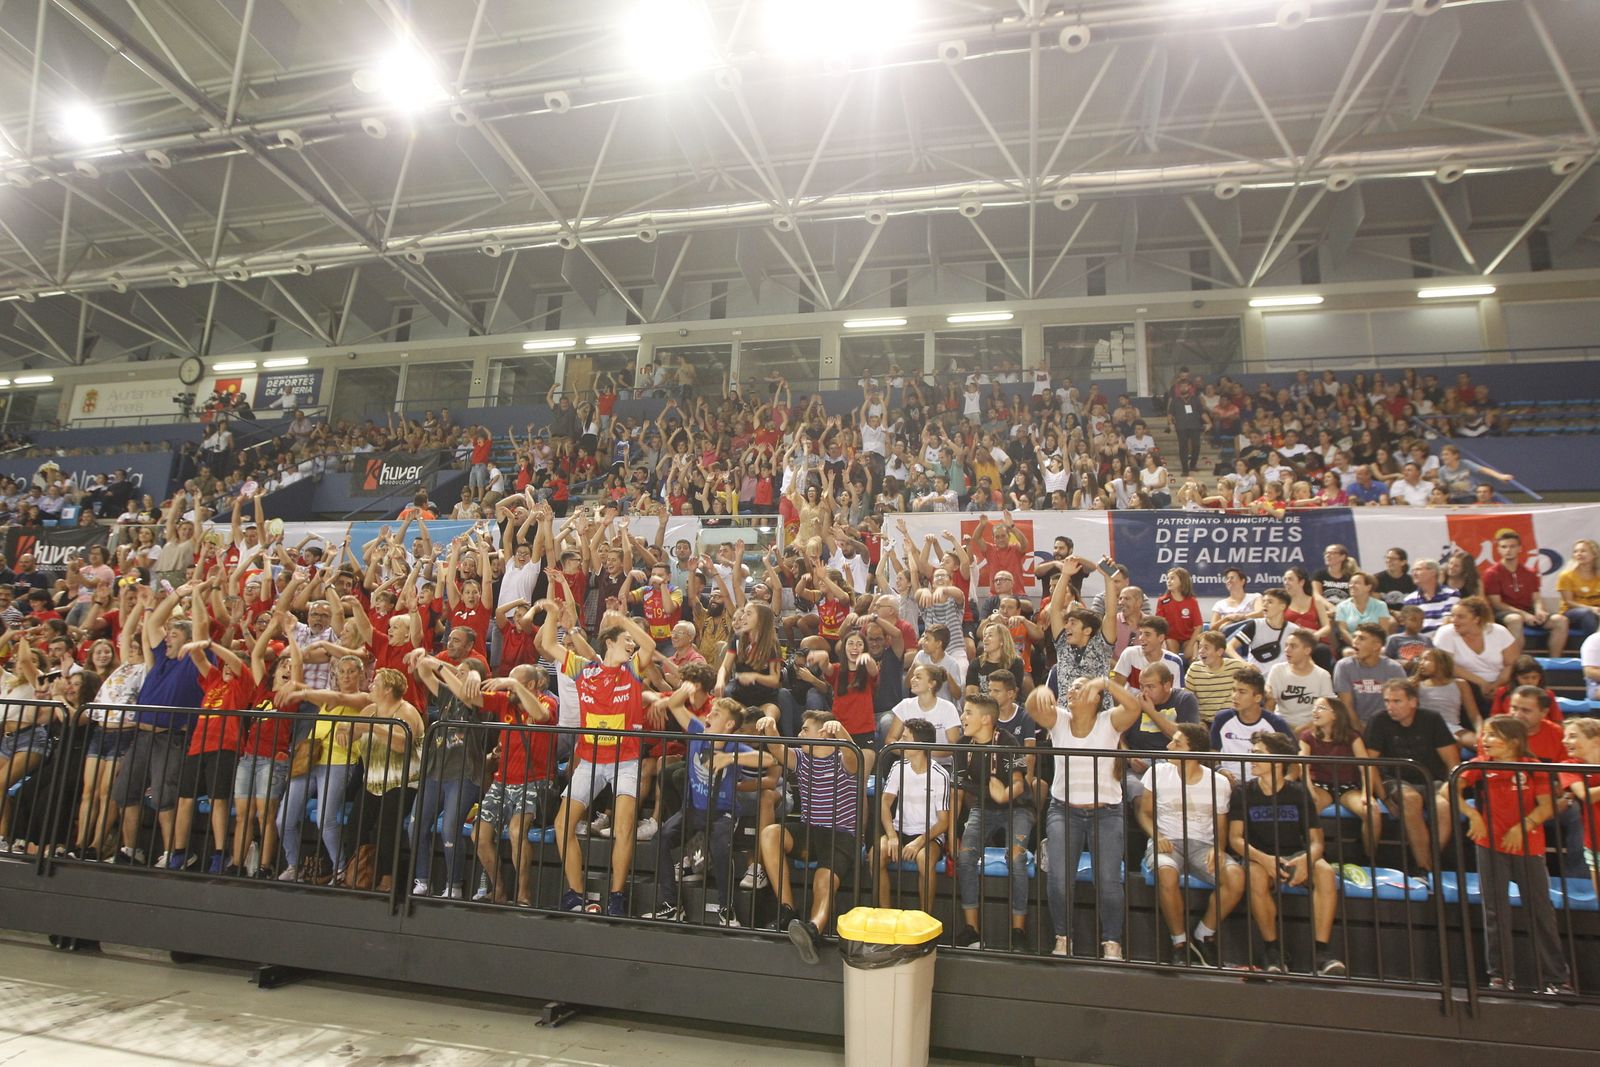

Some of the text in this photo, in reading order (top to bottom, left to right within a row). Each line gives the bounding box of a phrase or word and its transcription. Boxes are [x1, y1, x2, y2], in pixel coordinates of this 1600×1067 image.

[266, 378, 315, 388] DEPORTES
[265, 388, 276, 396] DE
[380, 463, 423, 485] kuver
[1156, 516, 1301, 525] PATRONATO MUNICIPAL DE
[1155, 526, 1303, 544] DEPORTES
[1157, 546, 1305, 563] DE ALMERIA
[1285, 685, 1306, 695] JUST
[612, 693, 630, 704] AVIS
